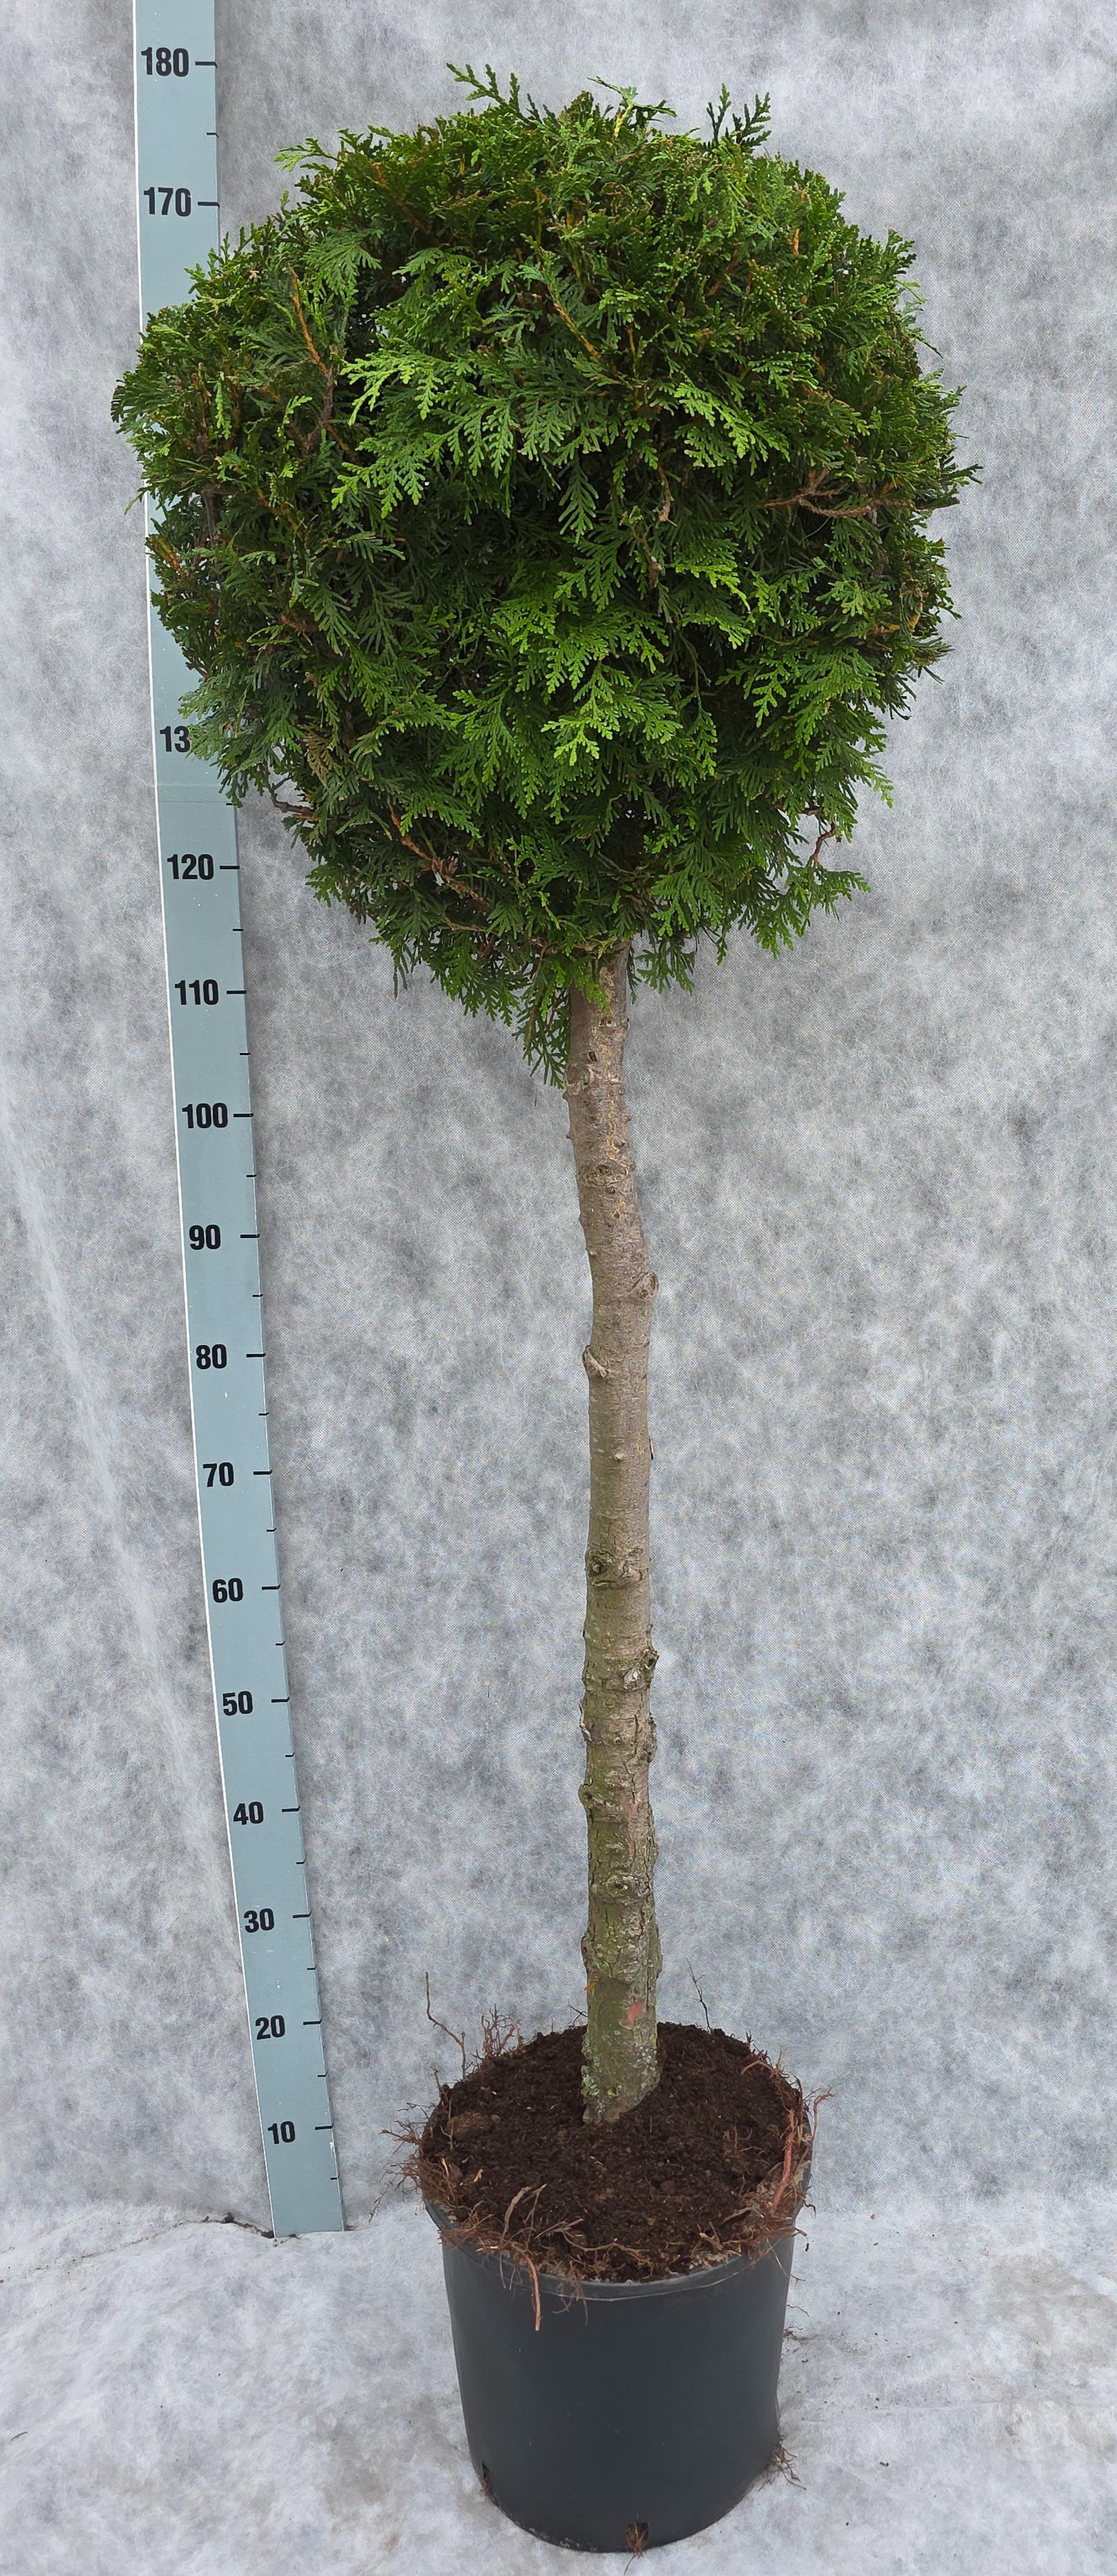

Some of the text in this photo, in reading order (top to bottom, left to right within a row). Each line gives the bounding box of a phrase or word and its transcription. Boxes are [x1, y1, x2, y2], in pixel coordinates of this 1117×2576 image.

[141, 47, 190, 77] 180
[143, 186, 192, 217] 170
[159, 725, 192, 753] 13
[166, 853, 215, 880] 120
[174, 978, 220, 1005] 110
[182, 1102, 229, 1129] 100
[188, 1224, 222, 1250] 90
[195, 1344, 228, 1370] 80
[202, 1462, 235, 1488] 70
[212, 1578, 244, 1603] 60
[222, 1690, 254, 1716] 50
[233, 1801, 264, 1826] 40
[243, 1908, 275, 1933] 30
[255, 2015, 286, 2040] 20
[267, 2120, 296, 2144] 10
